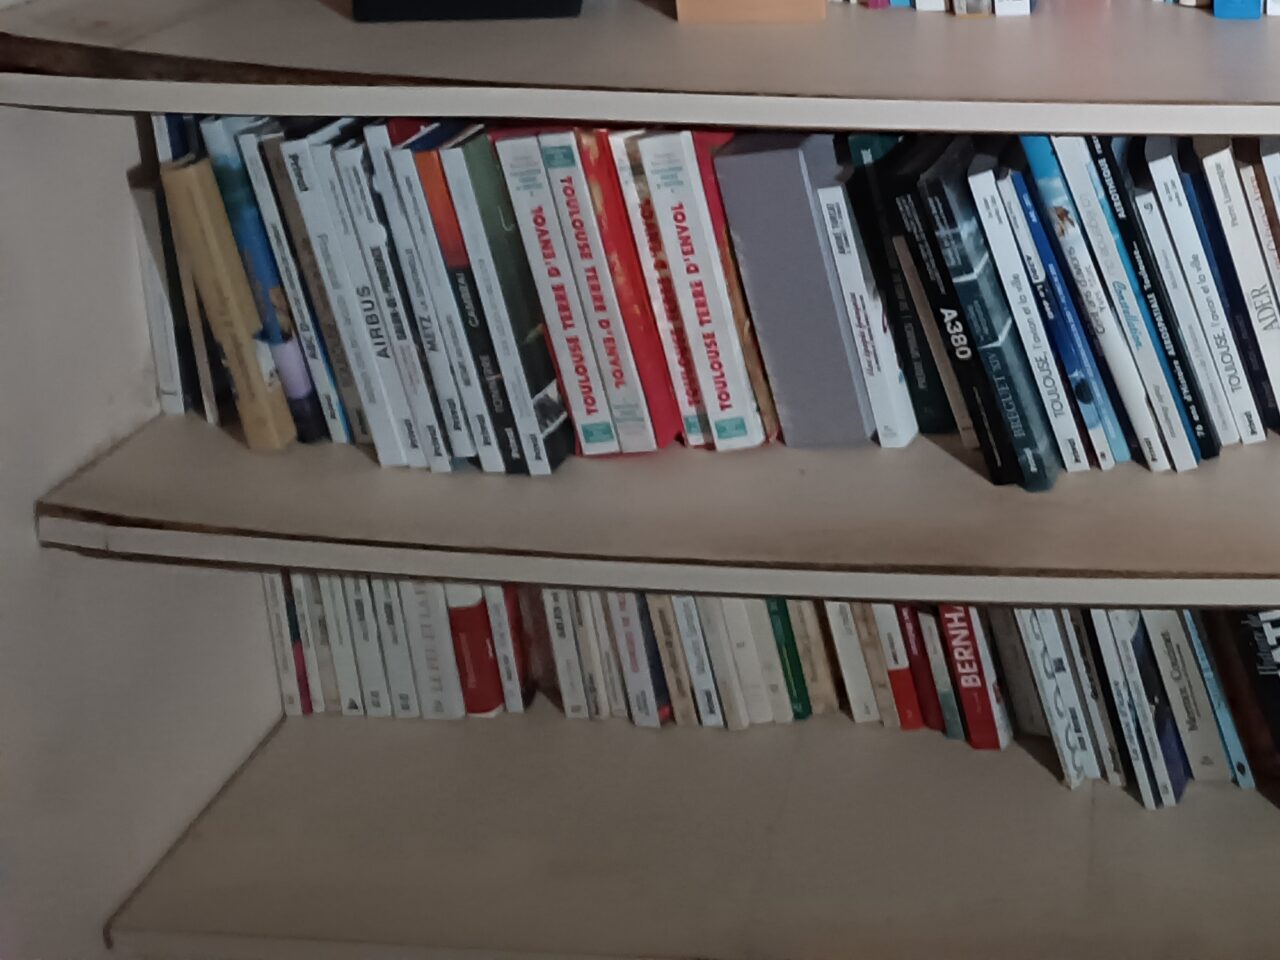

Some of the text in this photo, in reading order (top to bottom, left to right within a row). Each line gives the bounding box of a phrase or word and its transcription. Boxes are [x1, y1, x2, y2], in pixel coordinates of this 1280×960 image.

[670, 201, 699, 275] D'ENVOL
[1187, 253, 1203, 273] ville
[530, 204, 598, 416] TOULOUSE TERRE D'ENVOL
[559, 175, 626, 389] TOULOUSE TERRE D'ENVOL
[689, 278, 712, 326] TERRE
[1194, 273, 1207, 285] la
[1198, 283, 1210, 295] et
[1249, 282, 1280, 334] ADER
[355, 283, 390, 361] AIRBUS
[938, 302, 973, 363] A380
[702, 331, 733, 411] TOULOUSE
[991, 371, 1026, 439] BREGUET
